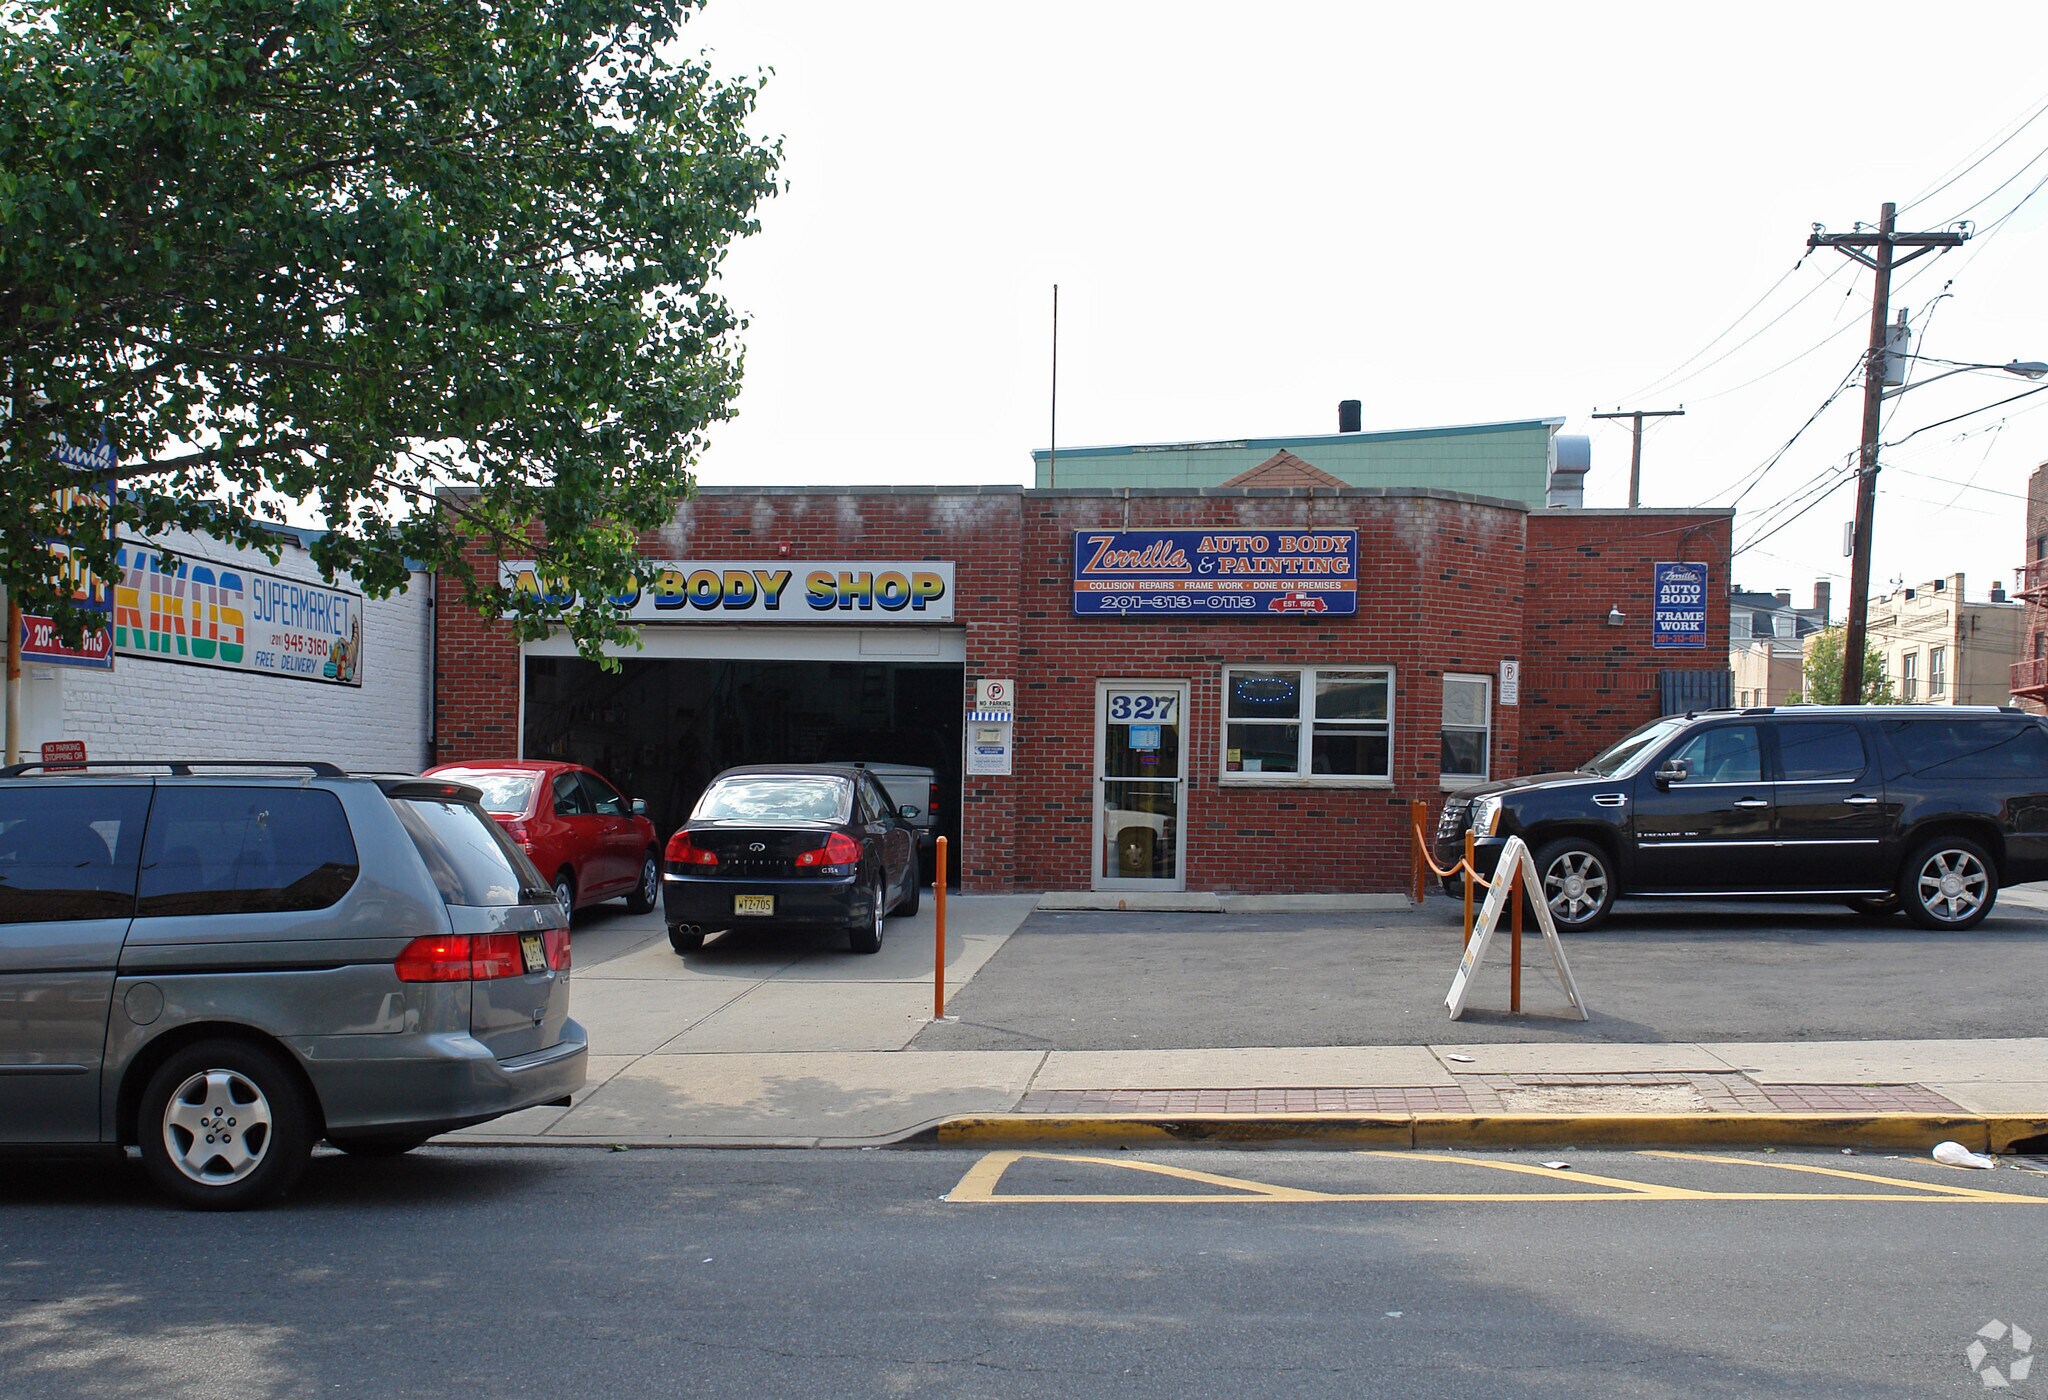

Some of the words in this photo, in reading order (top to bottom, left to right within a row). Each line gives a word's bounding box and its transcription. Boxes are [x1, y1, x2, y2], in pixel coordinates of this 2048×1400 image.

[1197, 536, 1270, 553] AUTO
[1278, 536, 1352, 553] BODY
[1082, 536, 1192, 574] Zorrilla
[1198, 556, 1216, 574] &
[1217, 557, 1351, 575] PAINTING
[1665, 571, 1698, 581] Zorrilla
[654, 569, 793, 611] BODY
[804, 570, 946, 611] SHOP
[1089, 582, 1135, 591] COLLISION
[1139, 582, 1175, 591] REPAIRS
[1184, 582, 1213, 591] FRAME
[1217, 582, 1244, 591] WORK
[1253, 582, 1277, 591] DONE
[1281, 582, 1294, 591] ON
[1298, 582, 1341, 591] PREMISES
[1660, 584, 1701, 594] AUTO
[1100, 595, 1256, 609] 201-313-0113
[1283, 600, 1298, 608] EST.
[1660, 594, 1701, 604] BODY
[115, 548, 244, 664] KIKOS
[253, 578, 349, 637] SUPERMARKET
[1656, 611, 1704, 621] FRAME
[1660, 621, 1700, 631] WORK
[254, 650, 274, 668] FREE
[281, 654, 317, 674] DELIVERY
[1111, 695, 1176, 720] 327
[56, 743, 80, 751] PARKING
[45, 753, 72, 761] STOPPING
[74, 751, 83, 760] OR
